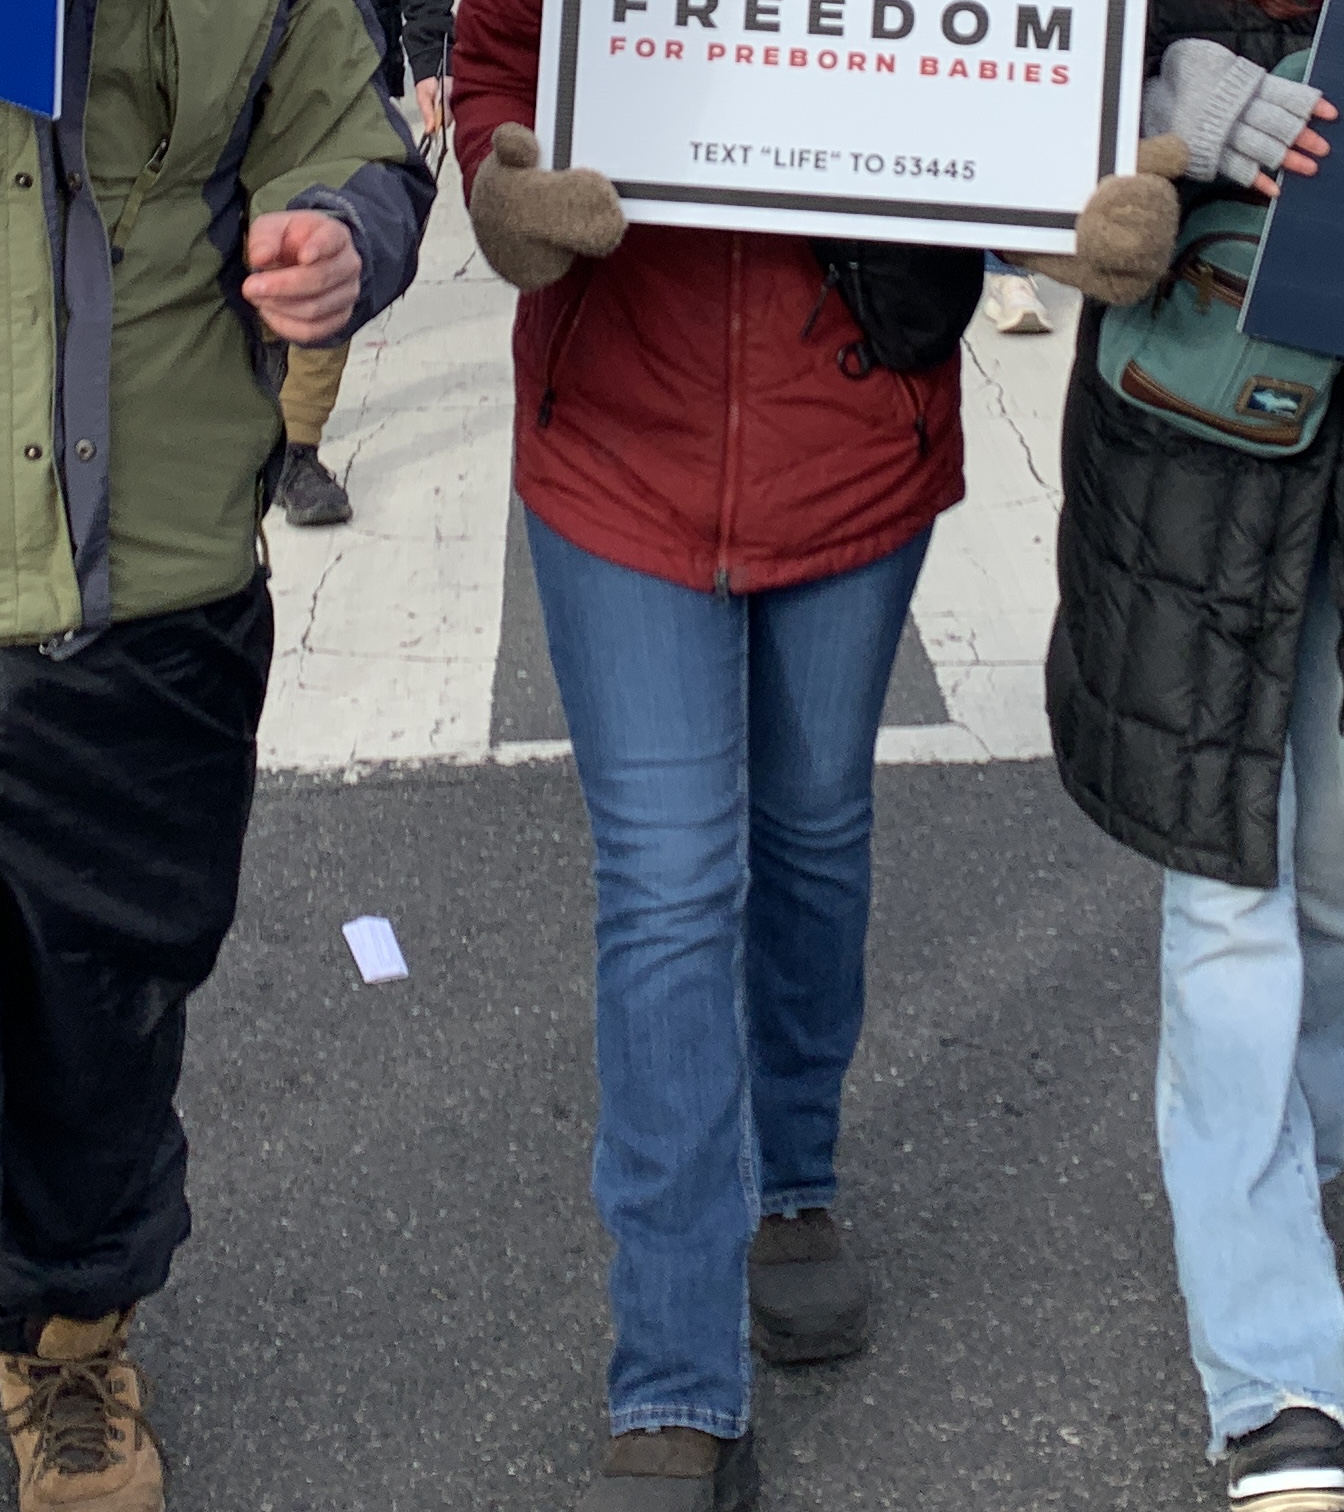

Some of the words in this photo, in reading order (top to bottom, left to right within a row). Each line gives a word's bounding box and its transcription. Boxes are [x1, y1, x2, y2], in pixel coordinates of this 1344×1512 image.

[609, 36, 684, 61] FOR
[707, 42, 897, 74] PREBORN
[919, 55, 1071, 86] BABIES
[690, 141, 753, 167] TEXT
[850, 151, 885, 175] TO
[893, 154, 976, 180] 53445
